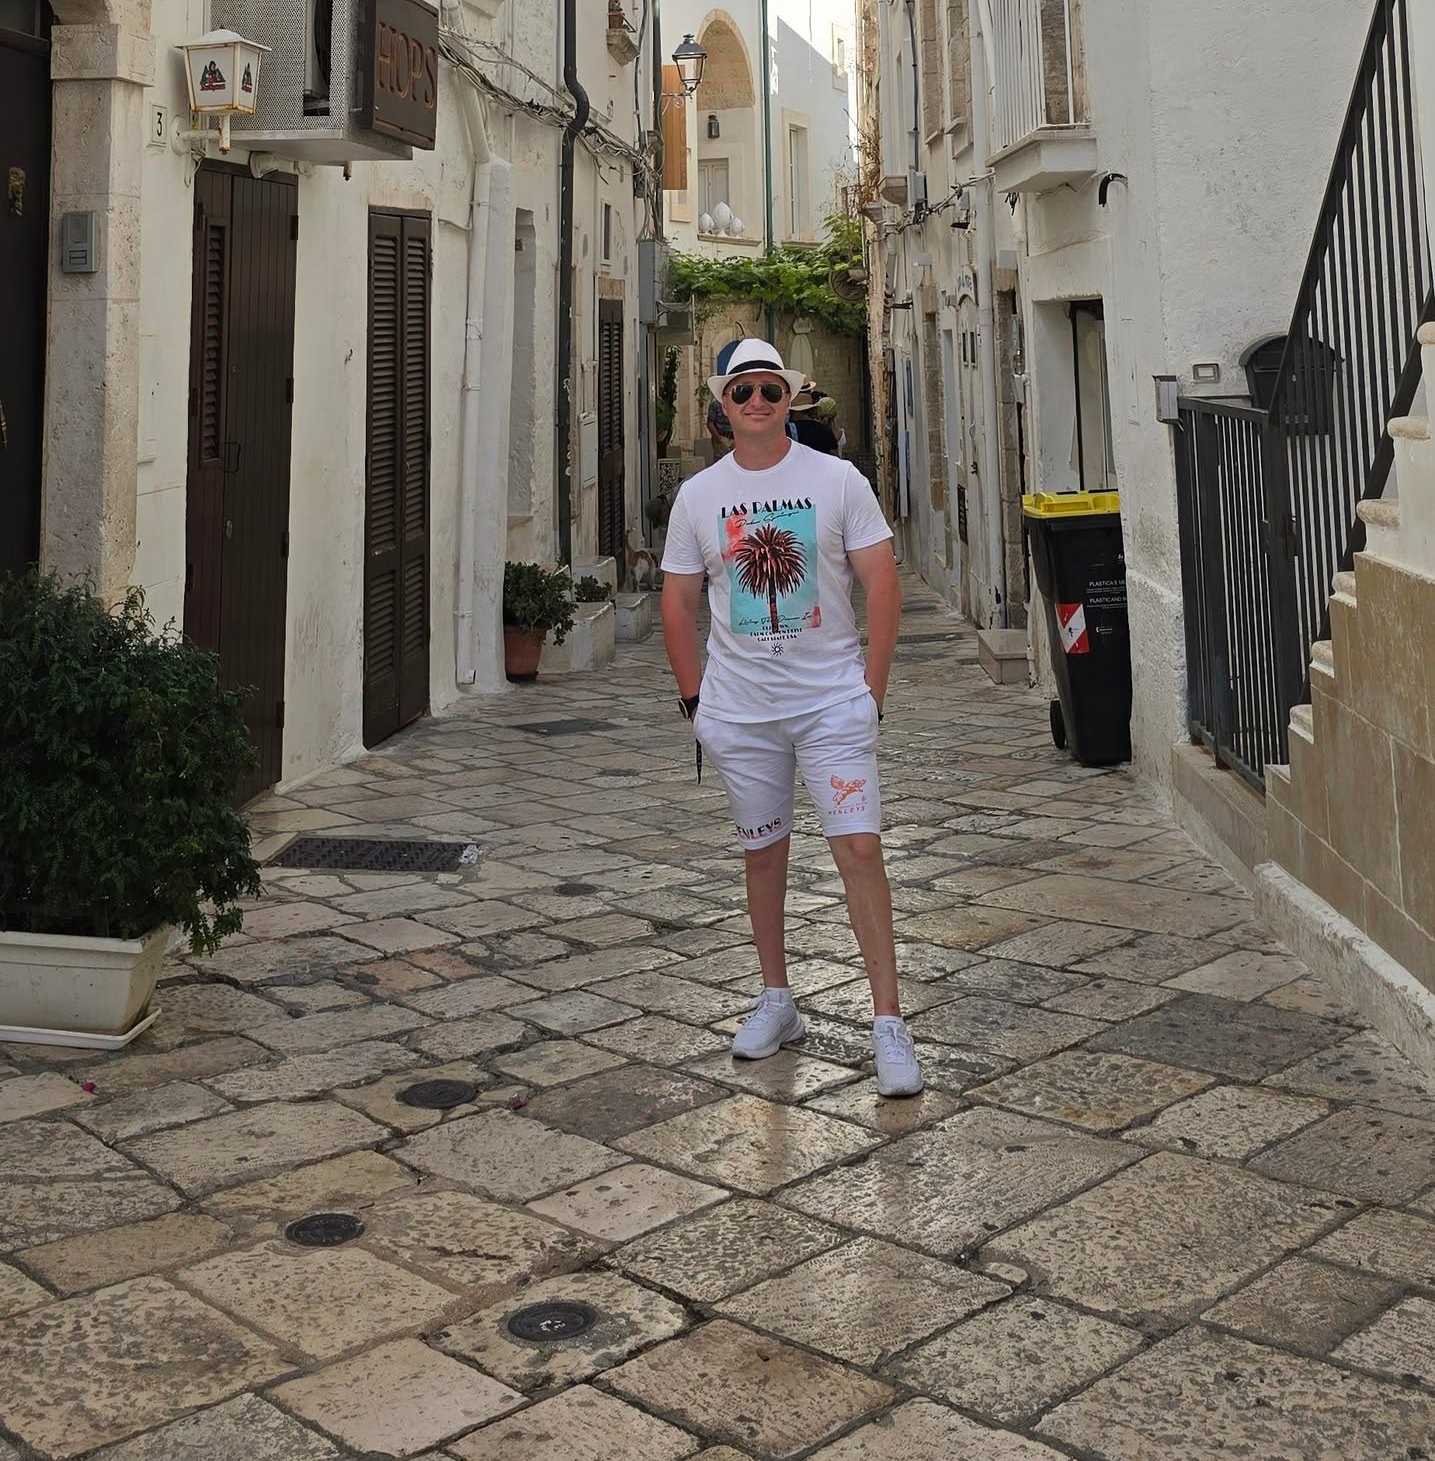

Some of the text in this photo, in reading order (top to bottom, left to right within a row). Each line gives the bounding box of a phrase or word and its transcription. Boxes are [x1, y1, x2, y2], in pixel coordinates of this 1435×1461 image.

[379, 20, 436, 109] HOPS
[156, 112, 163, 137] 3
[721, 497, 812, 519] LAS PALMAS
[828, 805, 865, 815] HENLEYS
[735, 817, 782, 839] ENLEYS
